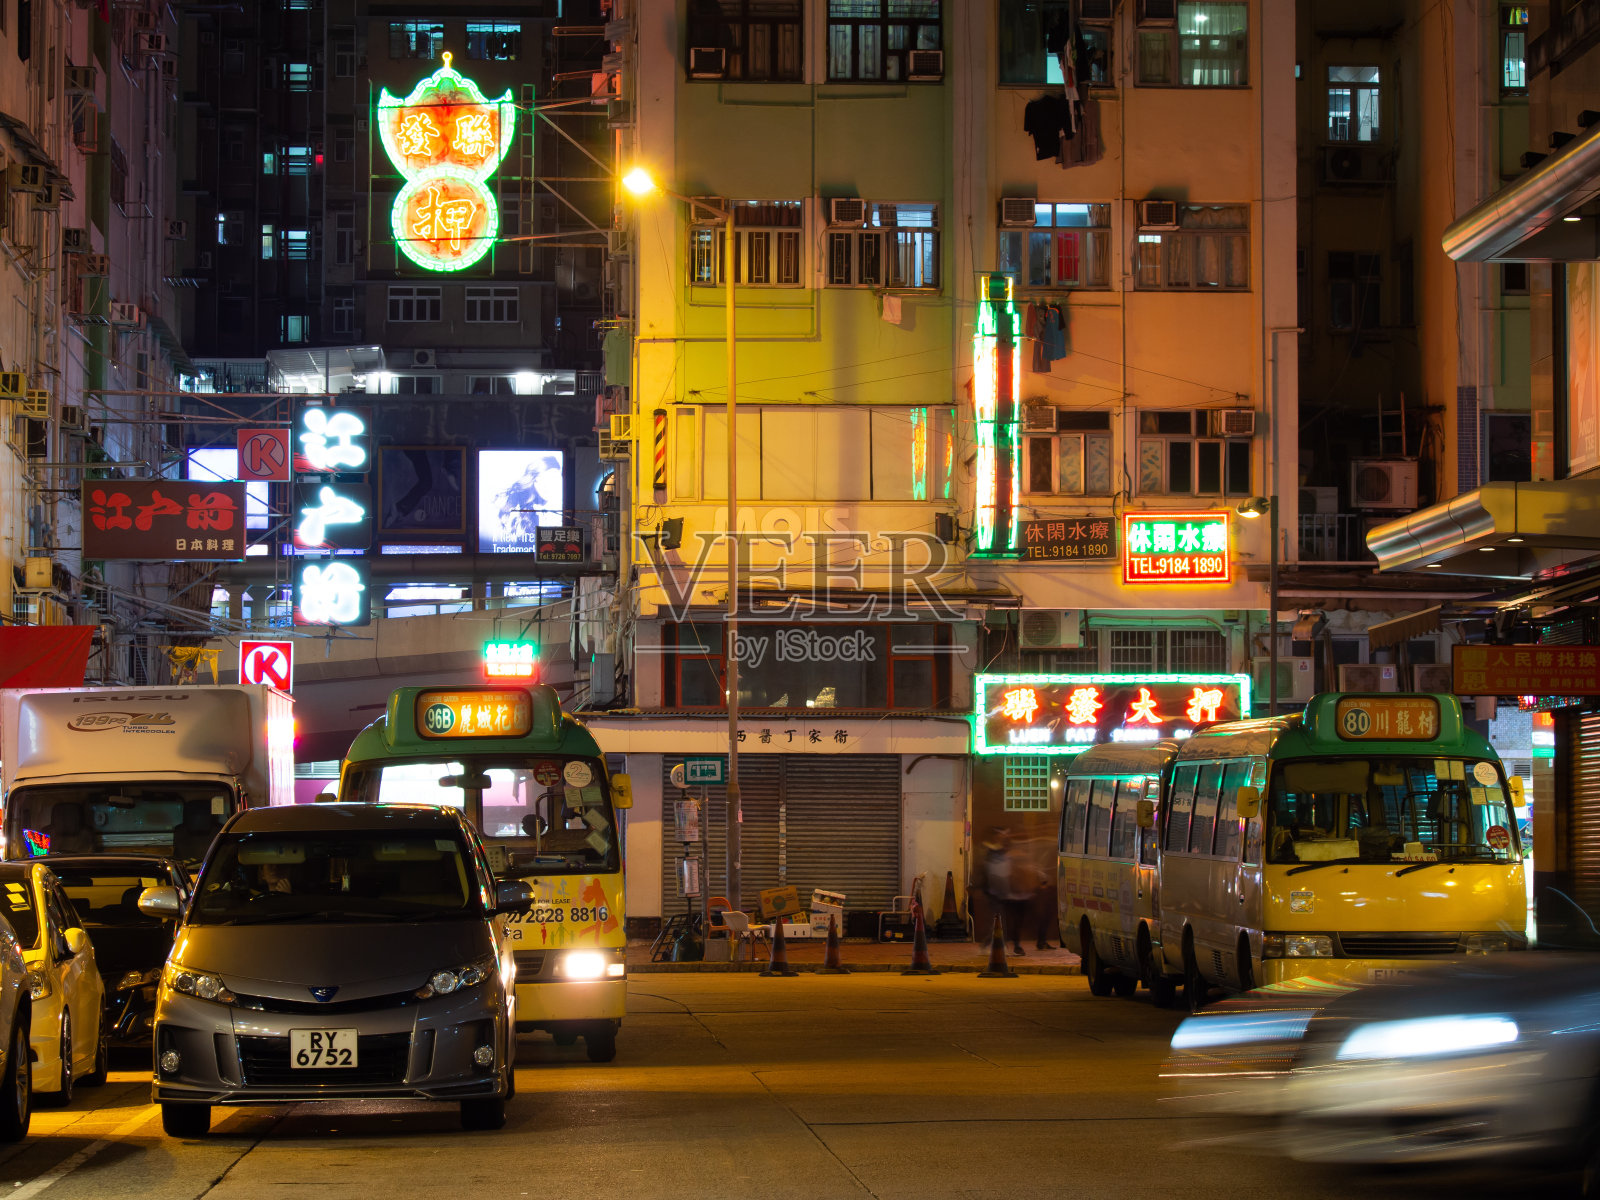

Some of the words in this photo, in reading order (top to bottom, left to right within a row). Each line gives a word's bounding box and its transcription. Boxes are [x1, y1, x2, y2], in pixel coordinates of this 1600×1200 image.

[412, 186, 477, 251] 押
[713, 506, 851, 546] MOIS
[176, 538, 235, 551] 日本料理
[500, 533, 515, 543] New
[1027, 545, 1079, 559] TEL:9184
[1082, 543, 1109, 556] 1890
[1130, 557, 1191, 574] TEL:9184
[1192, 556, 1223, 574] 1890
[253, 650, 286, 688] K
[73, 694, 190, 703] ISUZU
[1002, 687, 1224, 724] 聯發大押
[428, 708, 452, 729] 96B
[1346, 711, 1368, 733] 80
[1375, 710, 1434, 736] 川龍村
[525, 907, 565, 923] 2828
[570, 906, 608, 922] 8816
[310, 1031, 338, 1049] RY
[296, 1048, 353, 1066] 6752
